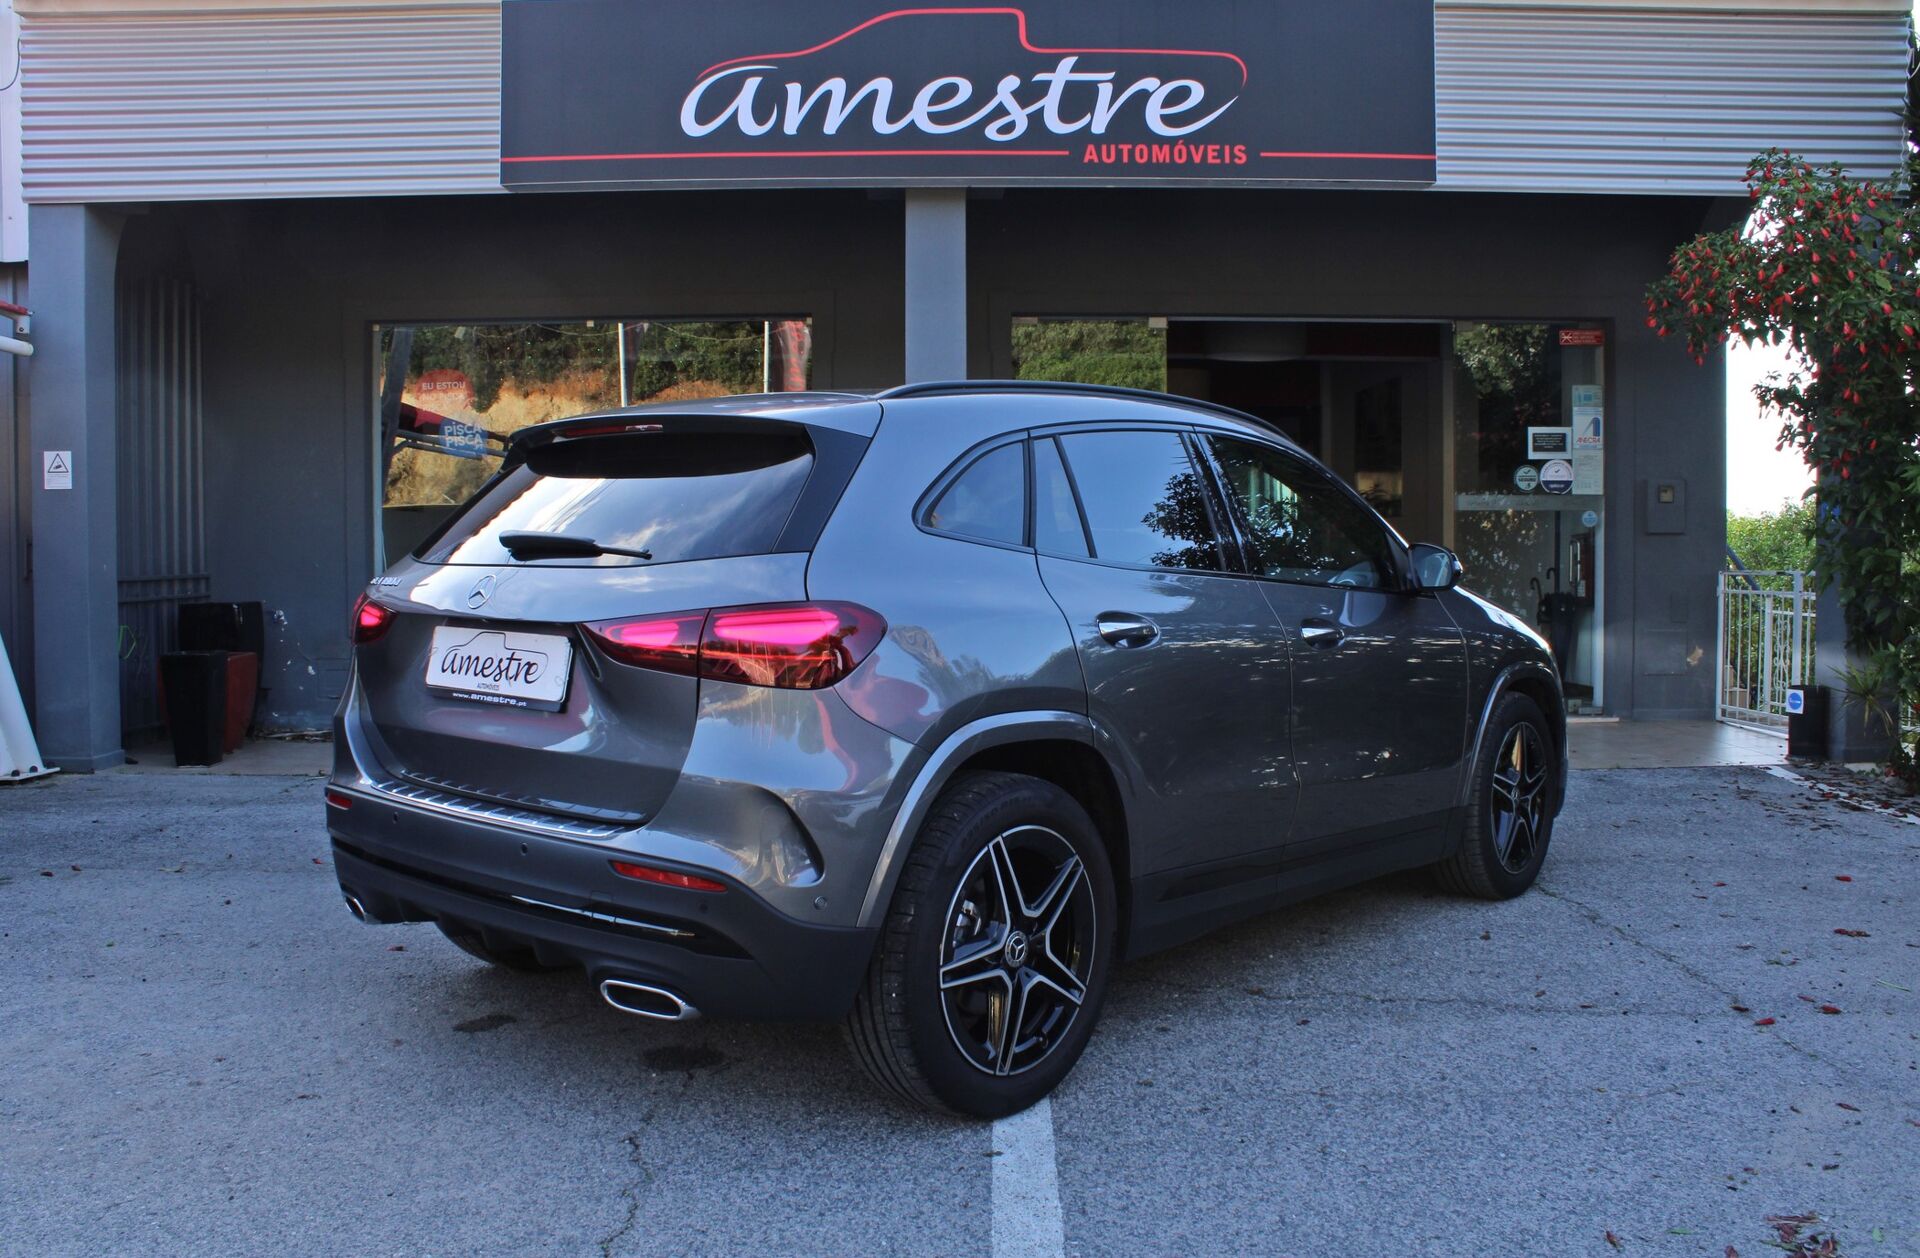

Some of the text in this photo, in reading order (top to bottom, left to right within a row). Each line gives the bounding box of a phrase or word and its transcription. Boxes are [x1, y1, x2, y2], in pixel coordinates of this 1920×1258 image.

[680, 56, 1239, 142] amestre
[1083, 140, 1248, 164] AUTOMÓVEIS
[436, 381, 465, 389] ESTOU
[441, 649, 541, 684] amestre
[452, 691, 527, 707] www.amestre.pt
